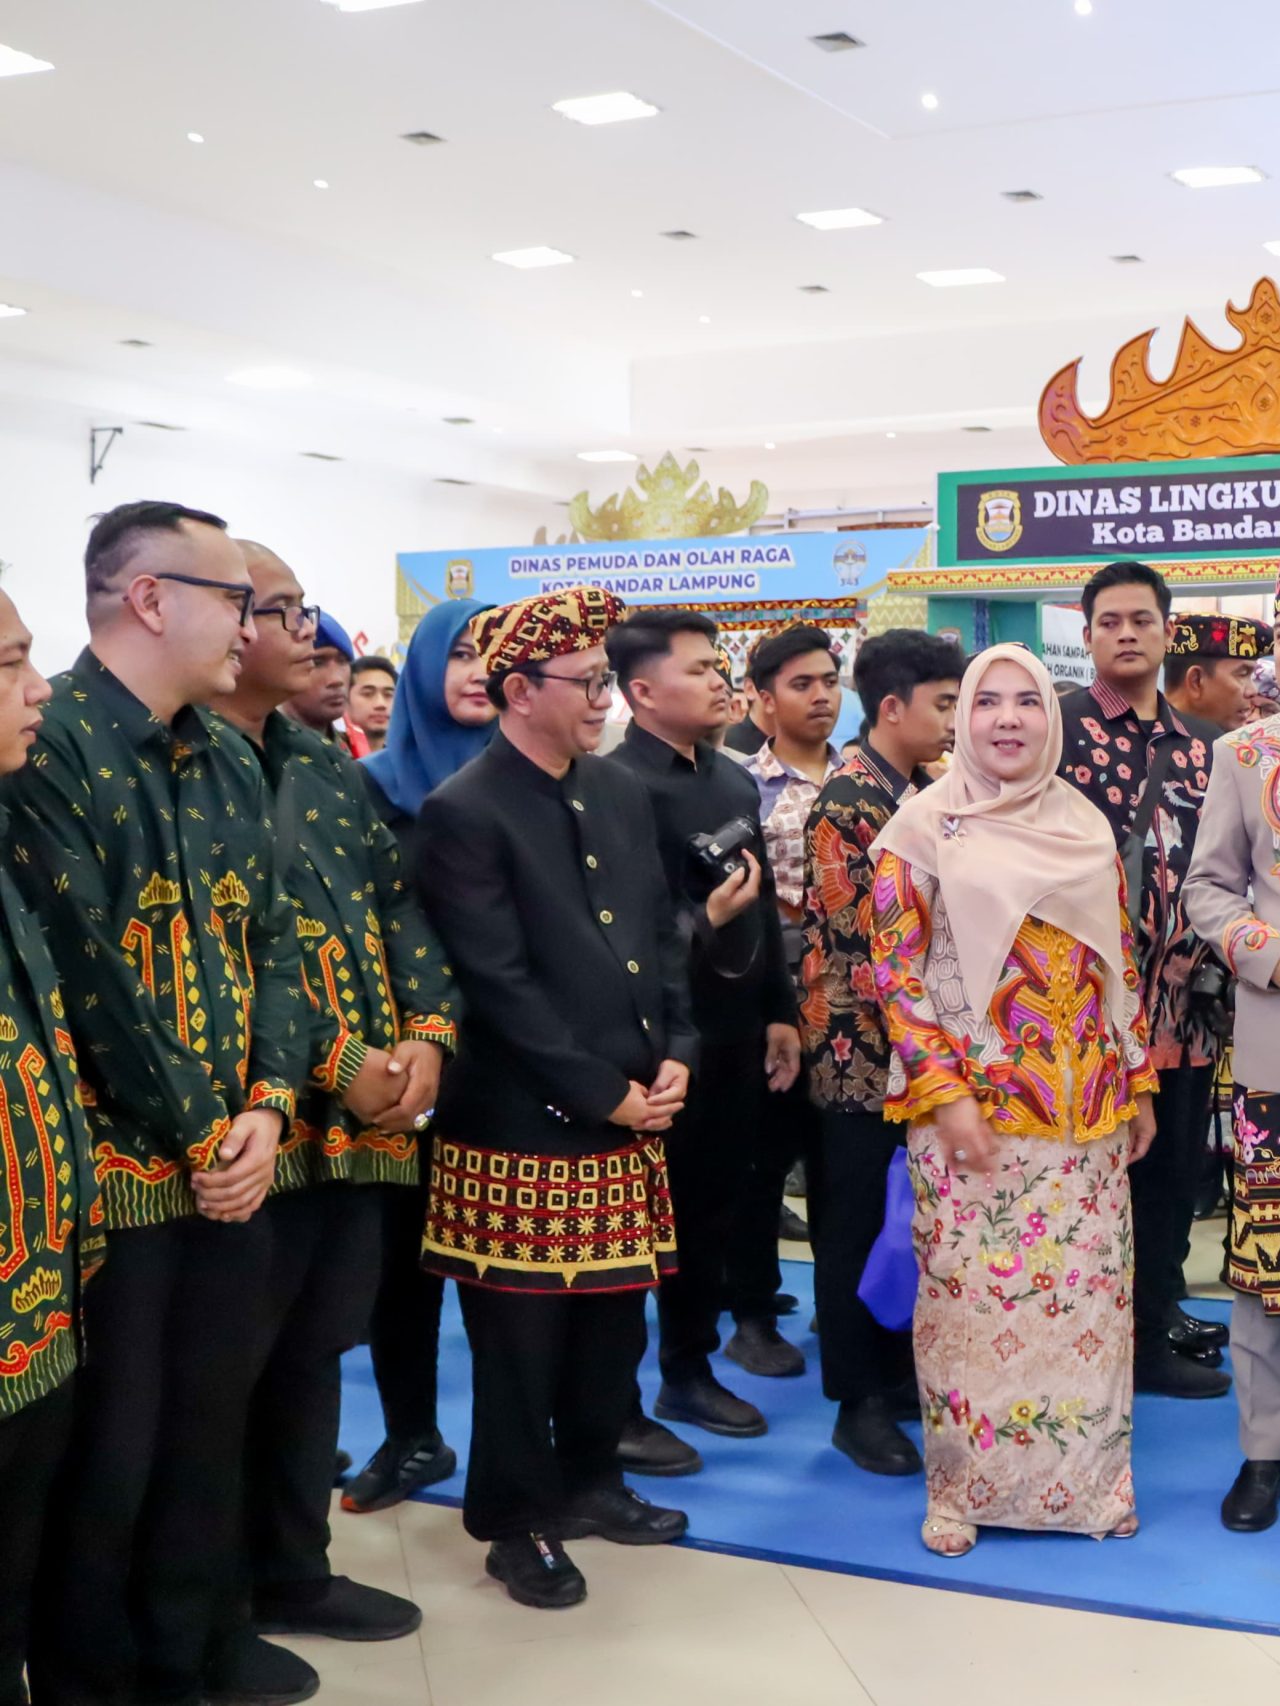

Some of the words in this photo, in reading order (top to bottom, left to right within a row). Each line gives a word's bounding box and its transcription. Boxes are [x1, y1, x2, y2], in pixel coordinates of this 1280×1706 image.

[1034, 485, 1142, 518] DINAS
[1093, 519, 1165, 545] Kota
[511, 558, 561, 573] DINAS
[567, 555, 638, 571] PEMUDA
[644, 552, 681, 567] DAN
[686, 550, 735, 566] OLAH
[741, 548, 791, 564] RAGA
[669, 574, 756, 591] LAMPUNG
[1054, 664, 1085, 679] ORGANIK
